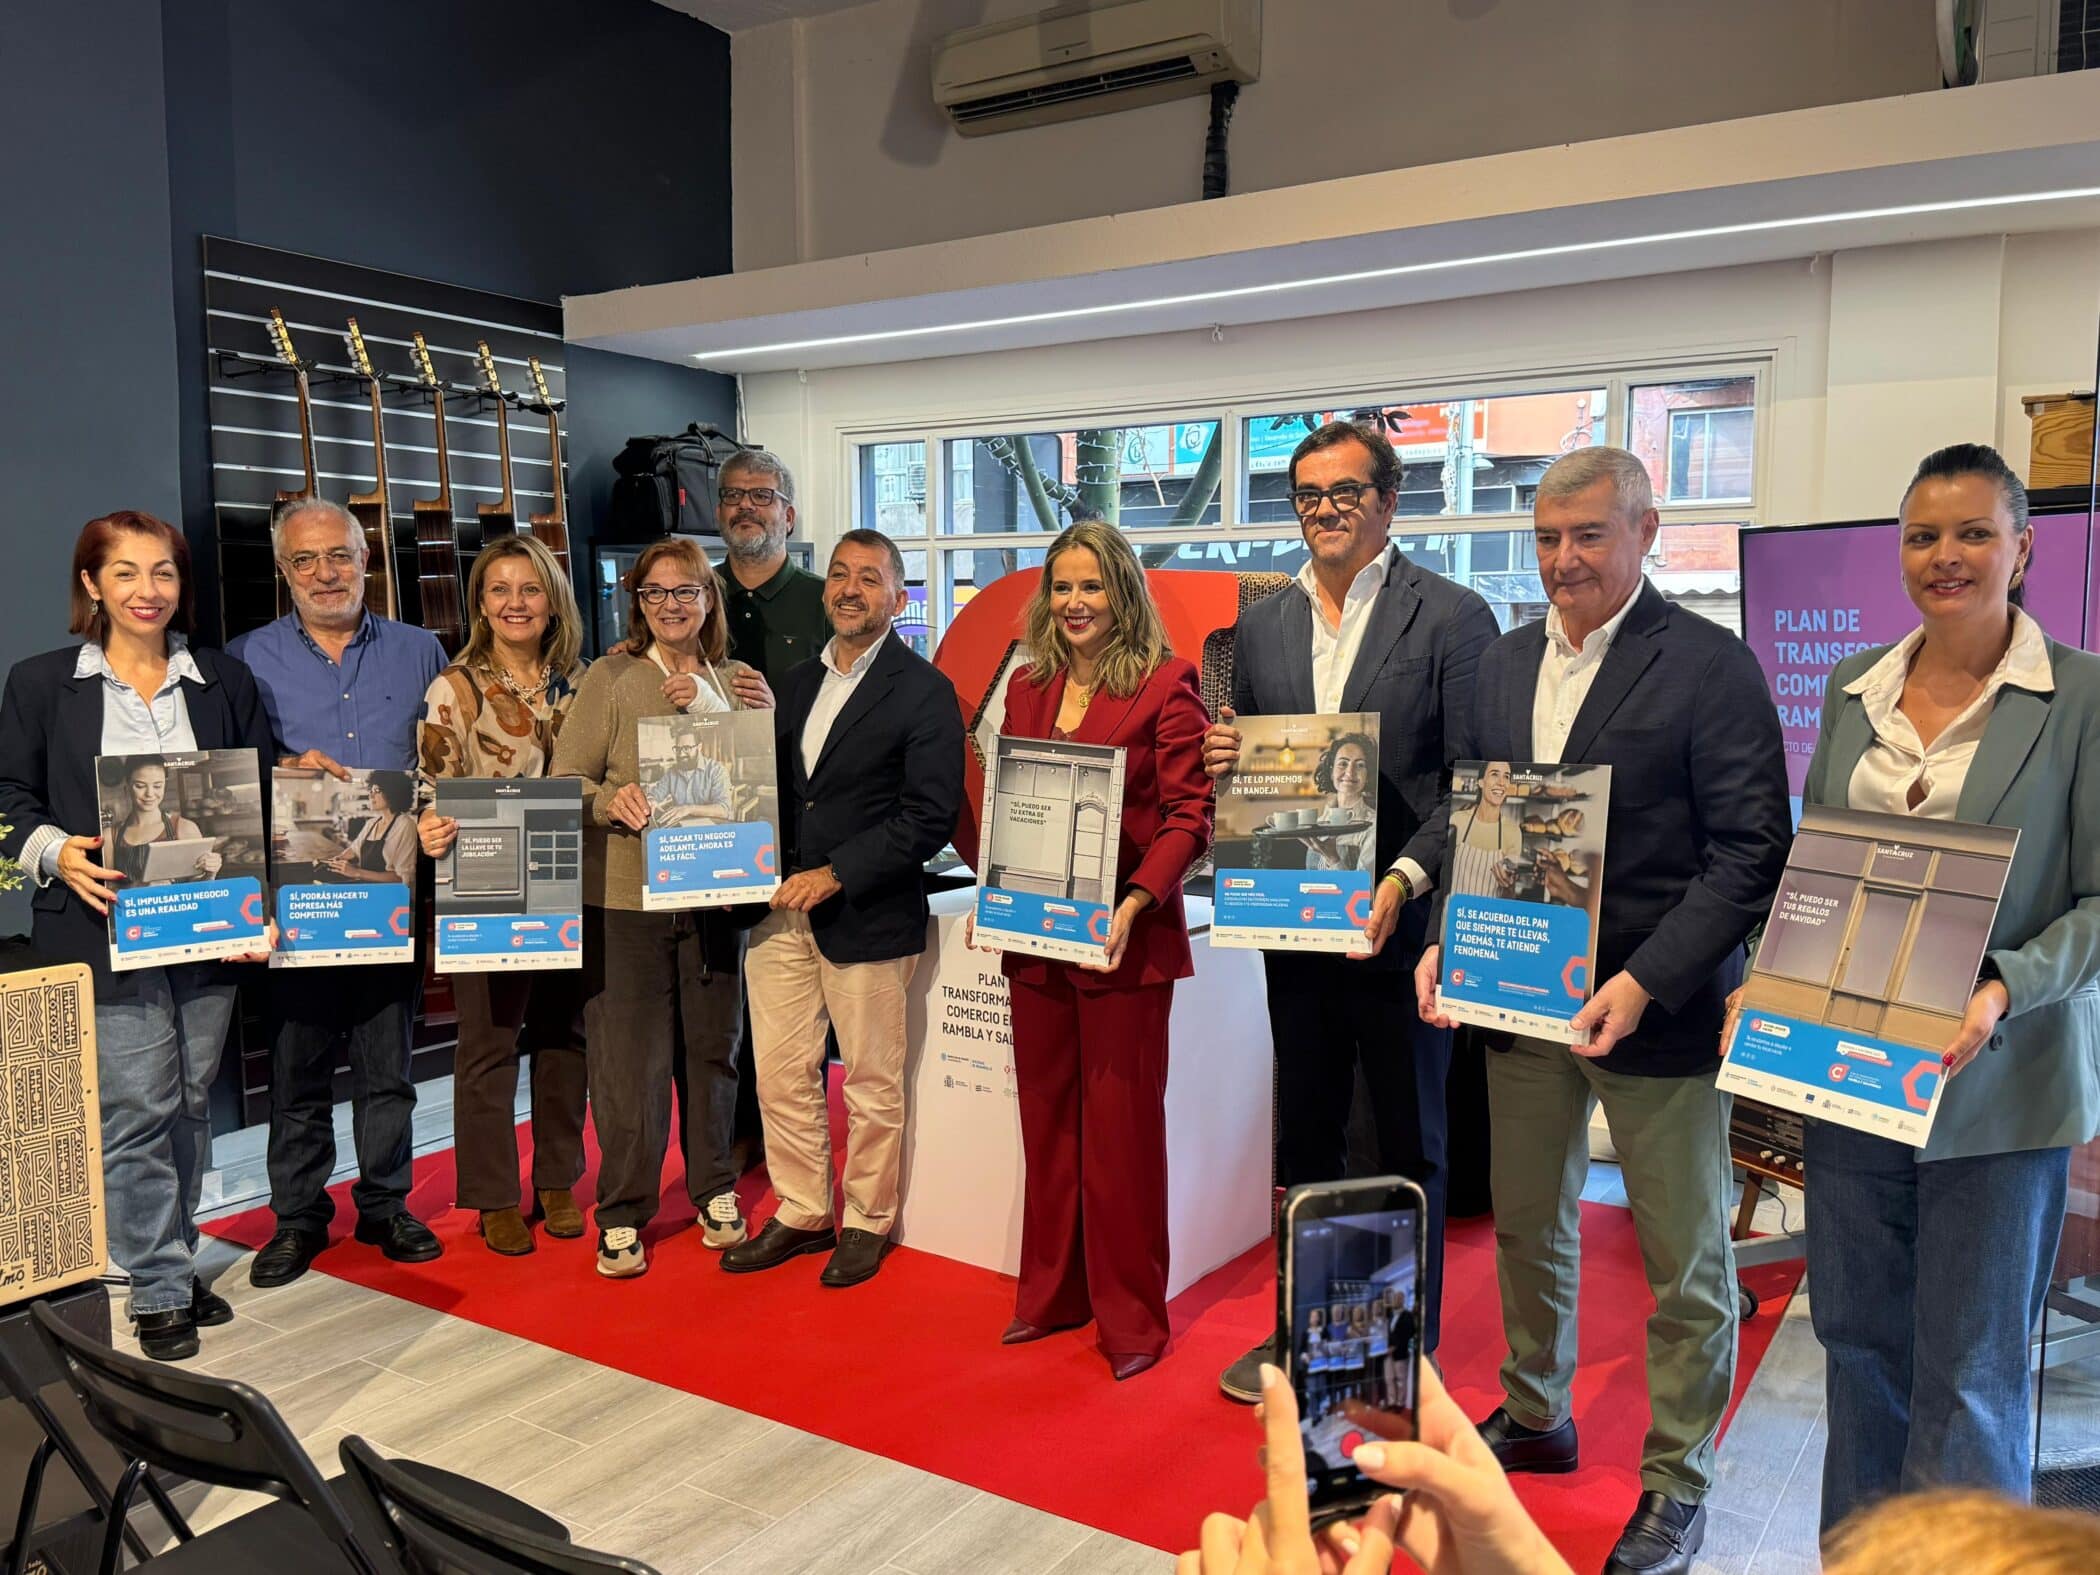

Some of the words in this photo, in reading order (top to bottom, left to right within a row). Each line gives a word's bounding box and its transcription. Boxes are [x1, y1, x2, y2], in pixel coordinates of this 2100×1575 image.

[1774, 609, 1827, 632] PLAN
[1833, 608, 1860, 632] DE
[1774, 641, 1890, 665] TRANSF
[1243, 775, 1253, 784] TE
[1253, 775, 1264, 784] LO
[1265, 775, 1303, 784] PONEMOS
[1231, 786, 1242, 795] EN
[1243, 786, 1279, 795] BANDEJA
[694, 832, 704, 841] TU
[704, 831, 736, 840] NEGOCIO
[699, 840, 724, 850] AHORA
[724, 840, 734, 849] ES
[124, 897, 137, 908] SÍ,
[137, 894, 179, 906] IMPULSAR
[181, 892, 192, 901] TU
[193, 889, 229, 900] NEGOCIO
[332, 891, 358, 900] HACER
[358, 891, 369, 899] TU
[126, 909, 137, 918] ES
[138, 906, 157, 917] UNA
[158, 902, 198, 914] REALIDAD
[289, 901, 326, 910] EMPRESA
[326, 900, 344, 910] MÁS
[1783, 901, 1798, 911] TUS
[1797, 904, 1830, 916] REGALOS
[288, 911, 340, 920] COMPETITIVA
[1457, 907, 1467, 919] SÍ,
[1467, 909, 1478, 920] SE
[1478, 911, 1515, 925] ACUERDA
[1515, 915, 1532, 927] DEL
[1532, 917, 1549, 929] PAN
[1778, 911, 1790, 920] DE
[1455, 920, 1472, 931] QUE
[1472, 922, 1507, 937] SIEMPRE
[1507, 926, 1518, 938] TE
[1518, 929, 1550, 944] LLEVAS,
[1455, 932, 1462, 942] Y
[1461, 933, 1495, 949] ADEMÁS,
[1496, 938, 1506, 949] TE
[1506, 941, 1541, 954] ATIENDE
[1453, 944, 1500, 960] FENOMENAL
[978, 972, 1005, 989] PLAN
[941, 985, 1012, 1008] TRANSFORMA
[946, 1004, 1000, 1025] COMERCIO
[1002, 1013, 1013, 1027] E
[942, 1021, 984, 1041] RAMBLA
[985, 1028, 994, 1042] Y
